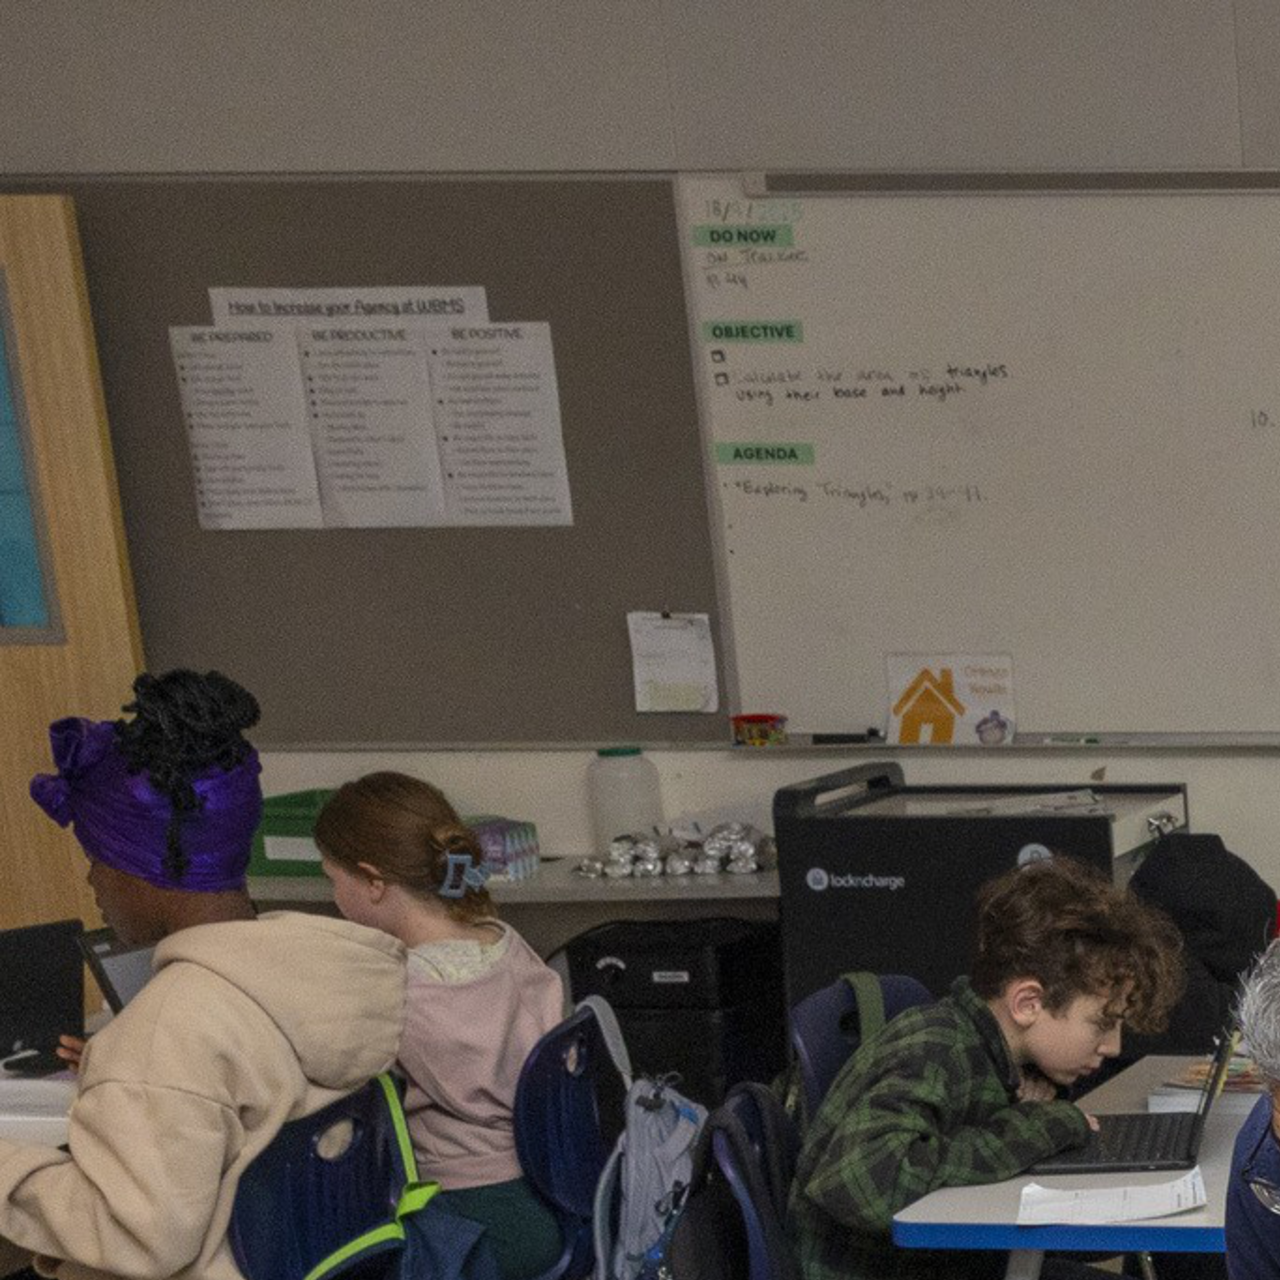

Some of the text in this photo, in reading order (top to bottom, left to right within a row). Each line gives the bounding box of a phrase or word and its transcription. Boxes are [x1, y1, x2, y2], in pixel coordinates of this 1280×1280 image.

[709, 229, 776, 242] DO NOW
[312, 330, 406, 341] BE PRODUCTIVE
[452, 328, 523, 340] BE POSITIVE
[712, 325, 795, 339] OBJECTIVE
[732, 447, 799, 461] AGENDA
